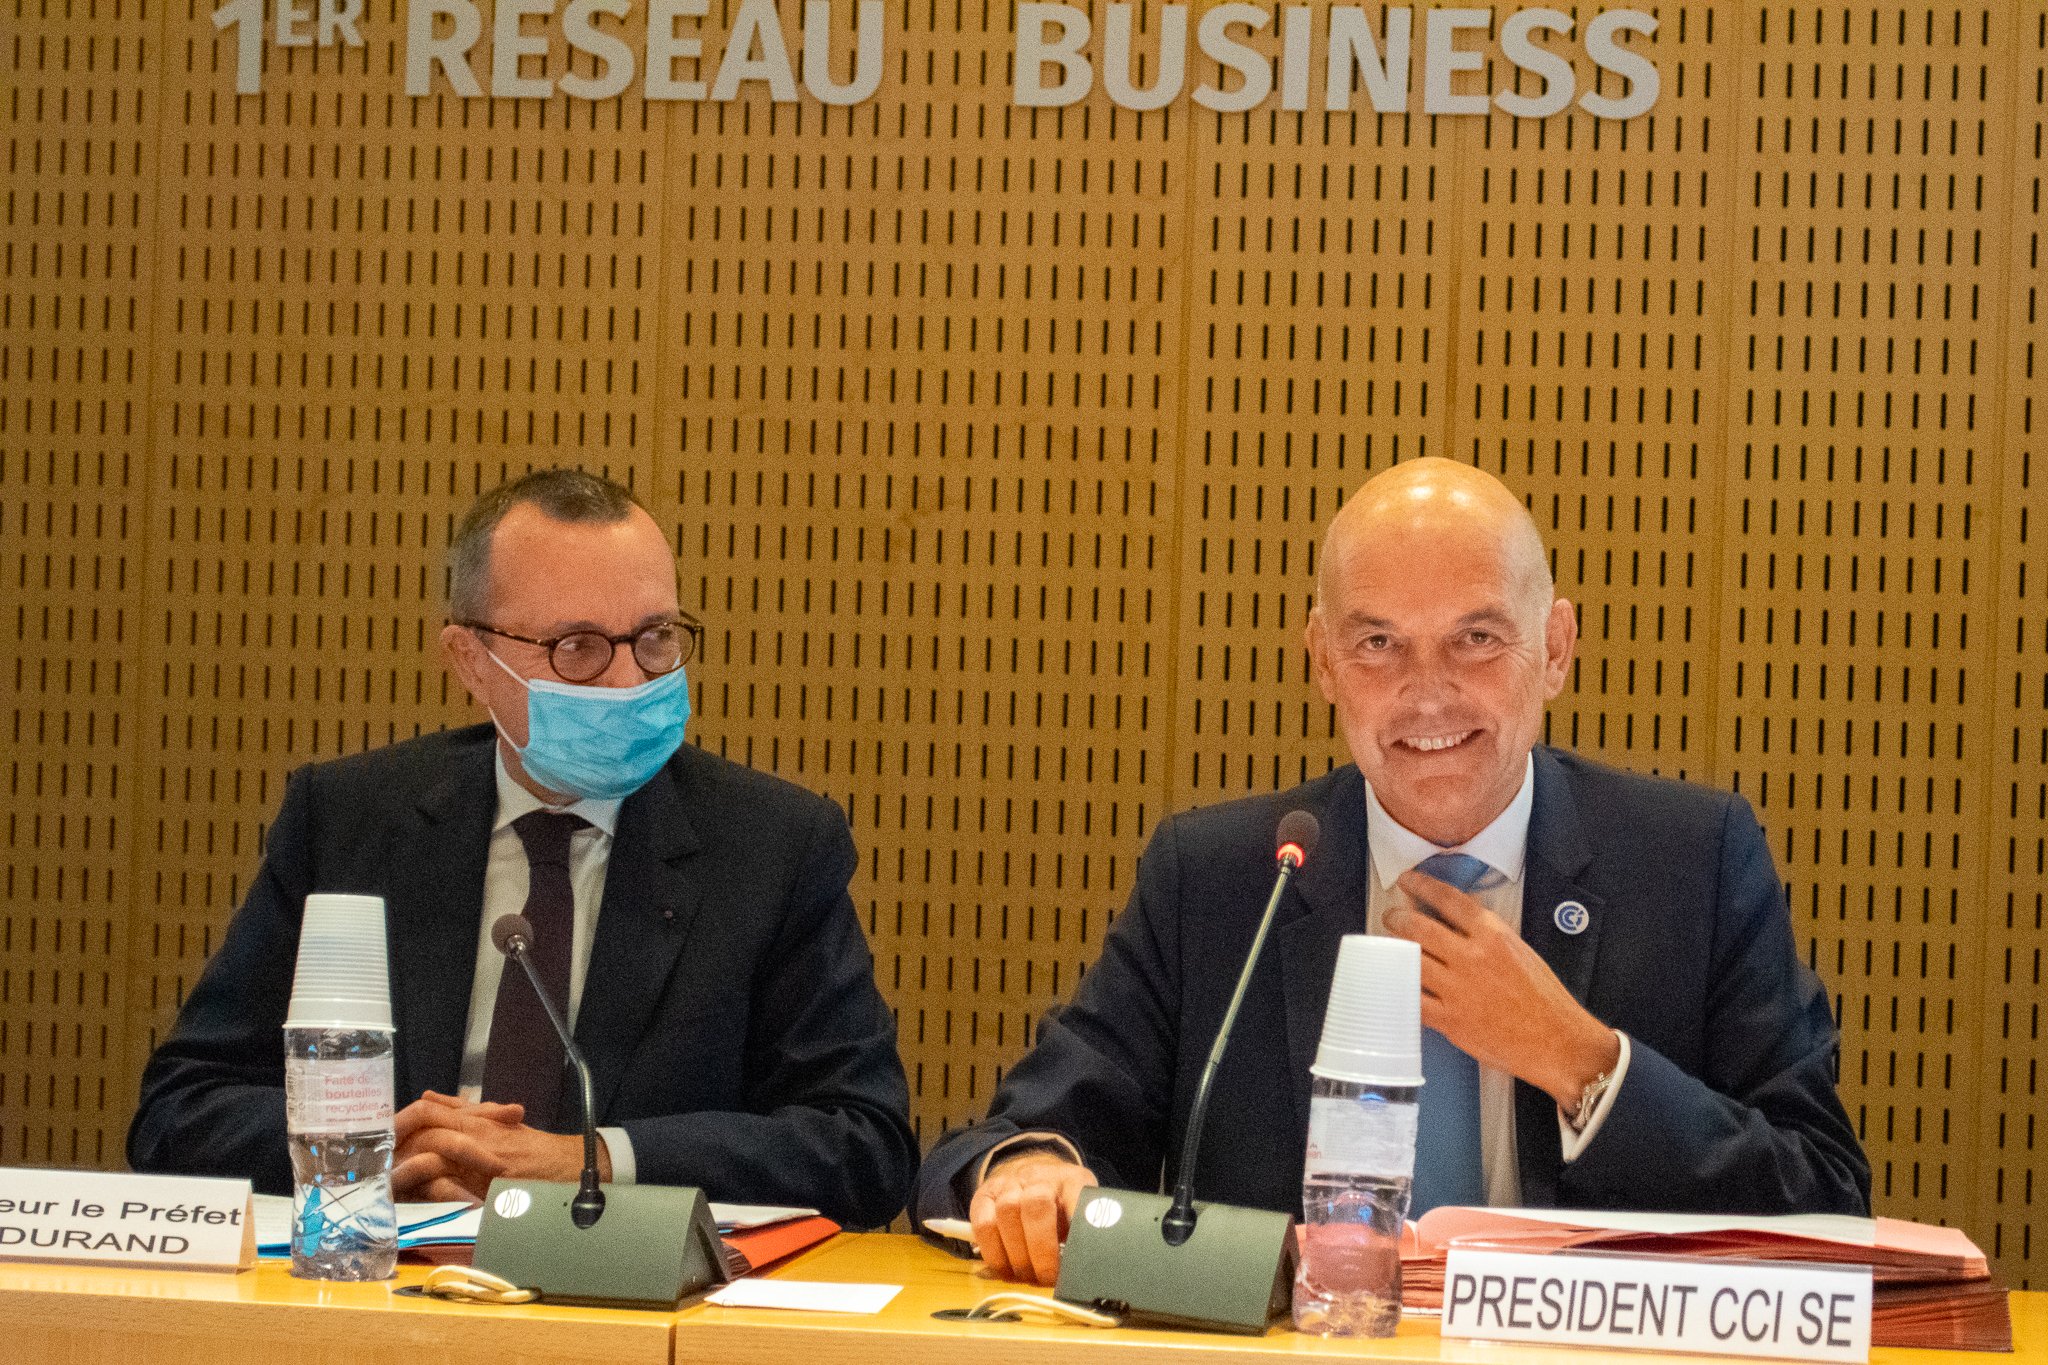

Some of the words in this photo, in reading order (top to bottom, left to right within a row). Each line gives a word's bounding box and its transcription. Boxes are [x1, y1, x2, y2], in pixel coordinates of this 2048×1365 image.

[404, 0, 884, 106] RESEAU
[1012, 2, 1660, 119] BUSINESS
[325, 1088, 382, 1099] bouteilles
[71, 1199, 105, 1218] le
[120, 1201, 242, 1226] Préfet
[0, 1226, 190, 1255] DURAND
[1448, 1273, 1698, 1337] PRESIDENT
[1710, 1287, 1783, 1342] CCI
[1796, 1292, 1855, 1347] SE
